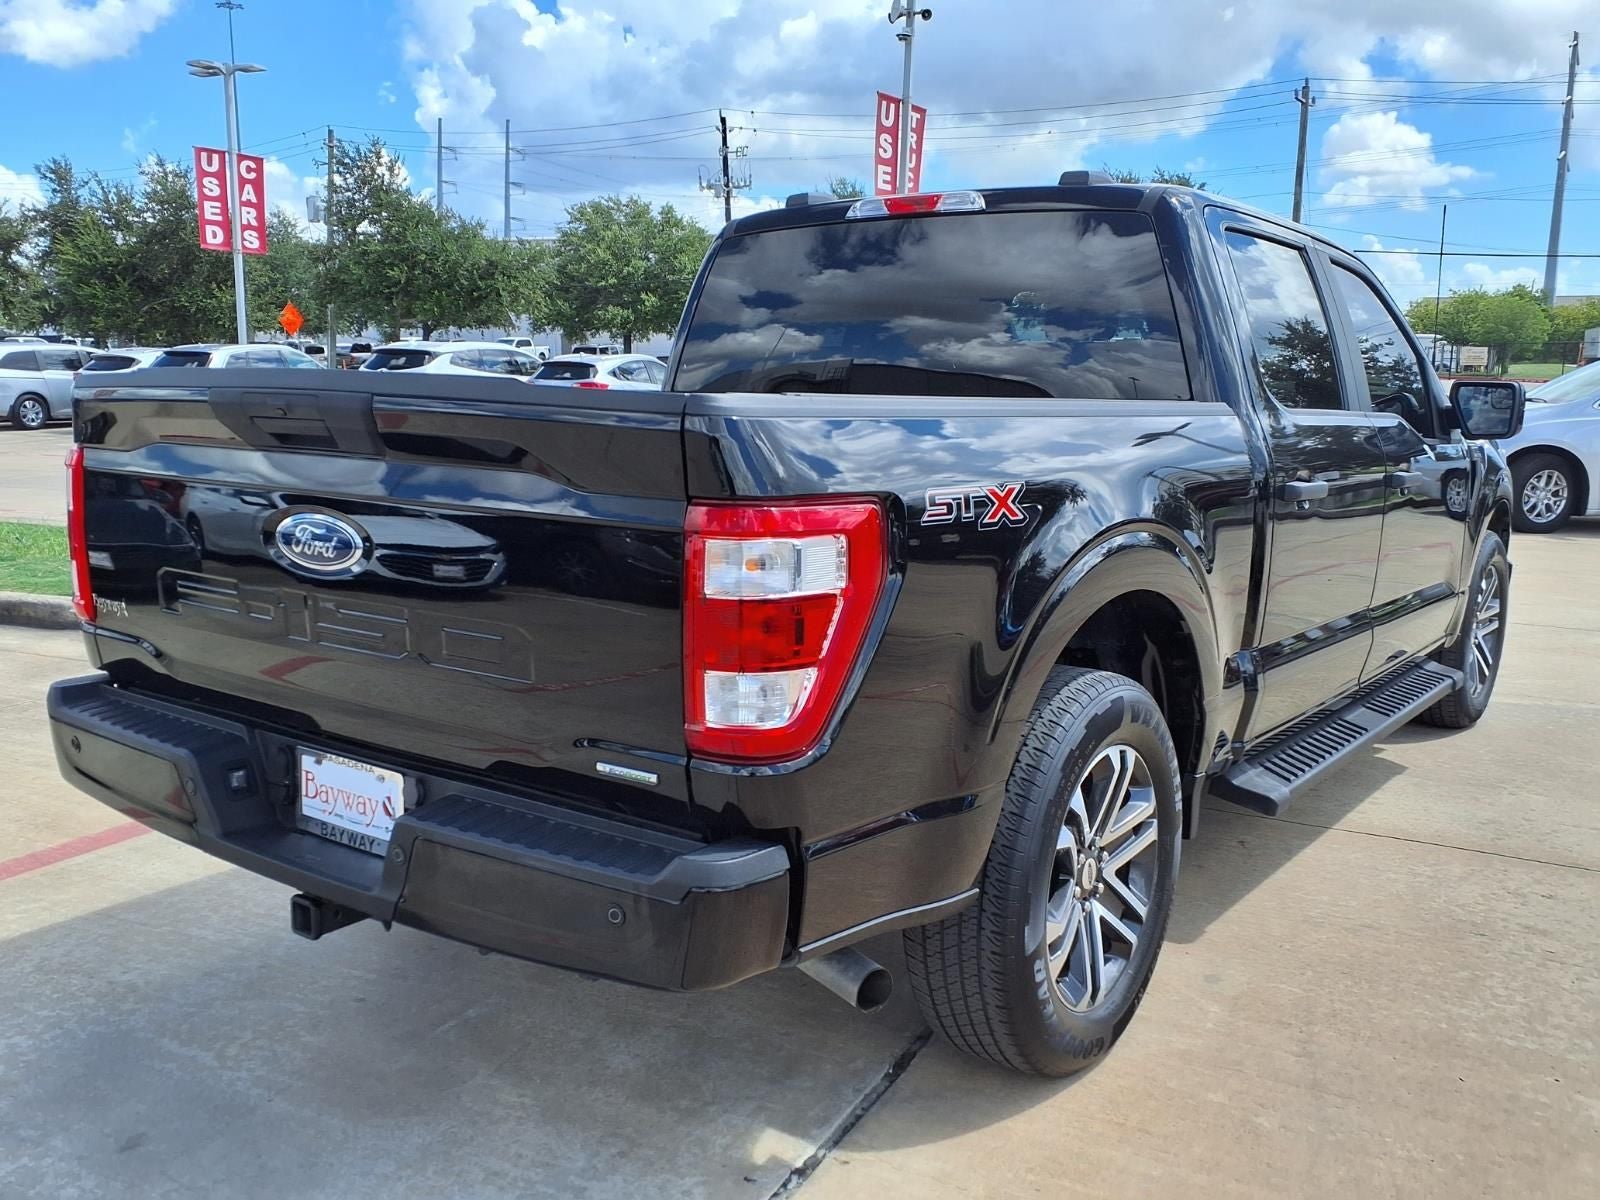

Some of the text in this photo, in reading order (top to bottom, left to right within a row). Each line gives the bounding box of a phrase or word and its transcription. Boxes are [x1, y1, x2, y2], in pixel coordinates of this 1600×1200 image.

[200, 151, 224, 245] USED
[239, 160, 260, 249] CARS
[921, 481, 1030, 531] STX
[320, 754, 376, 775] PASADENA
[302, 768, 380, 828] Bayway
[319, 821, 375, 851] BAYWAY
